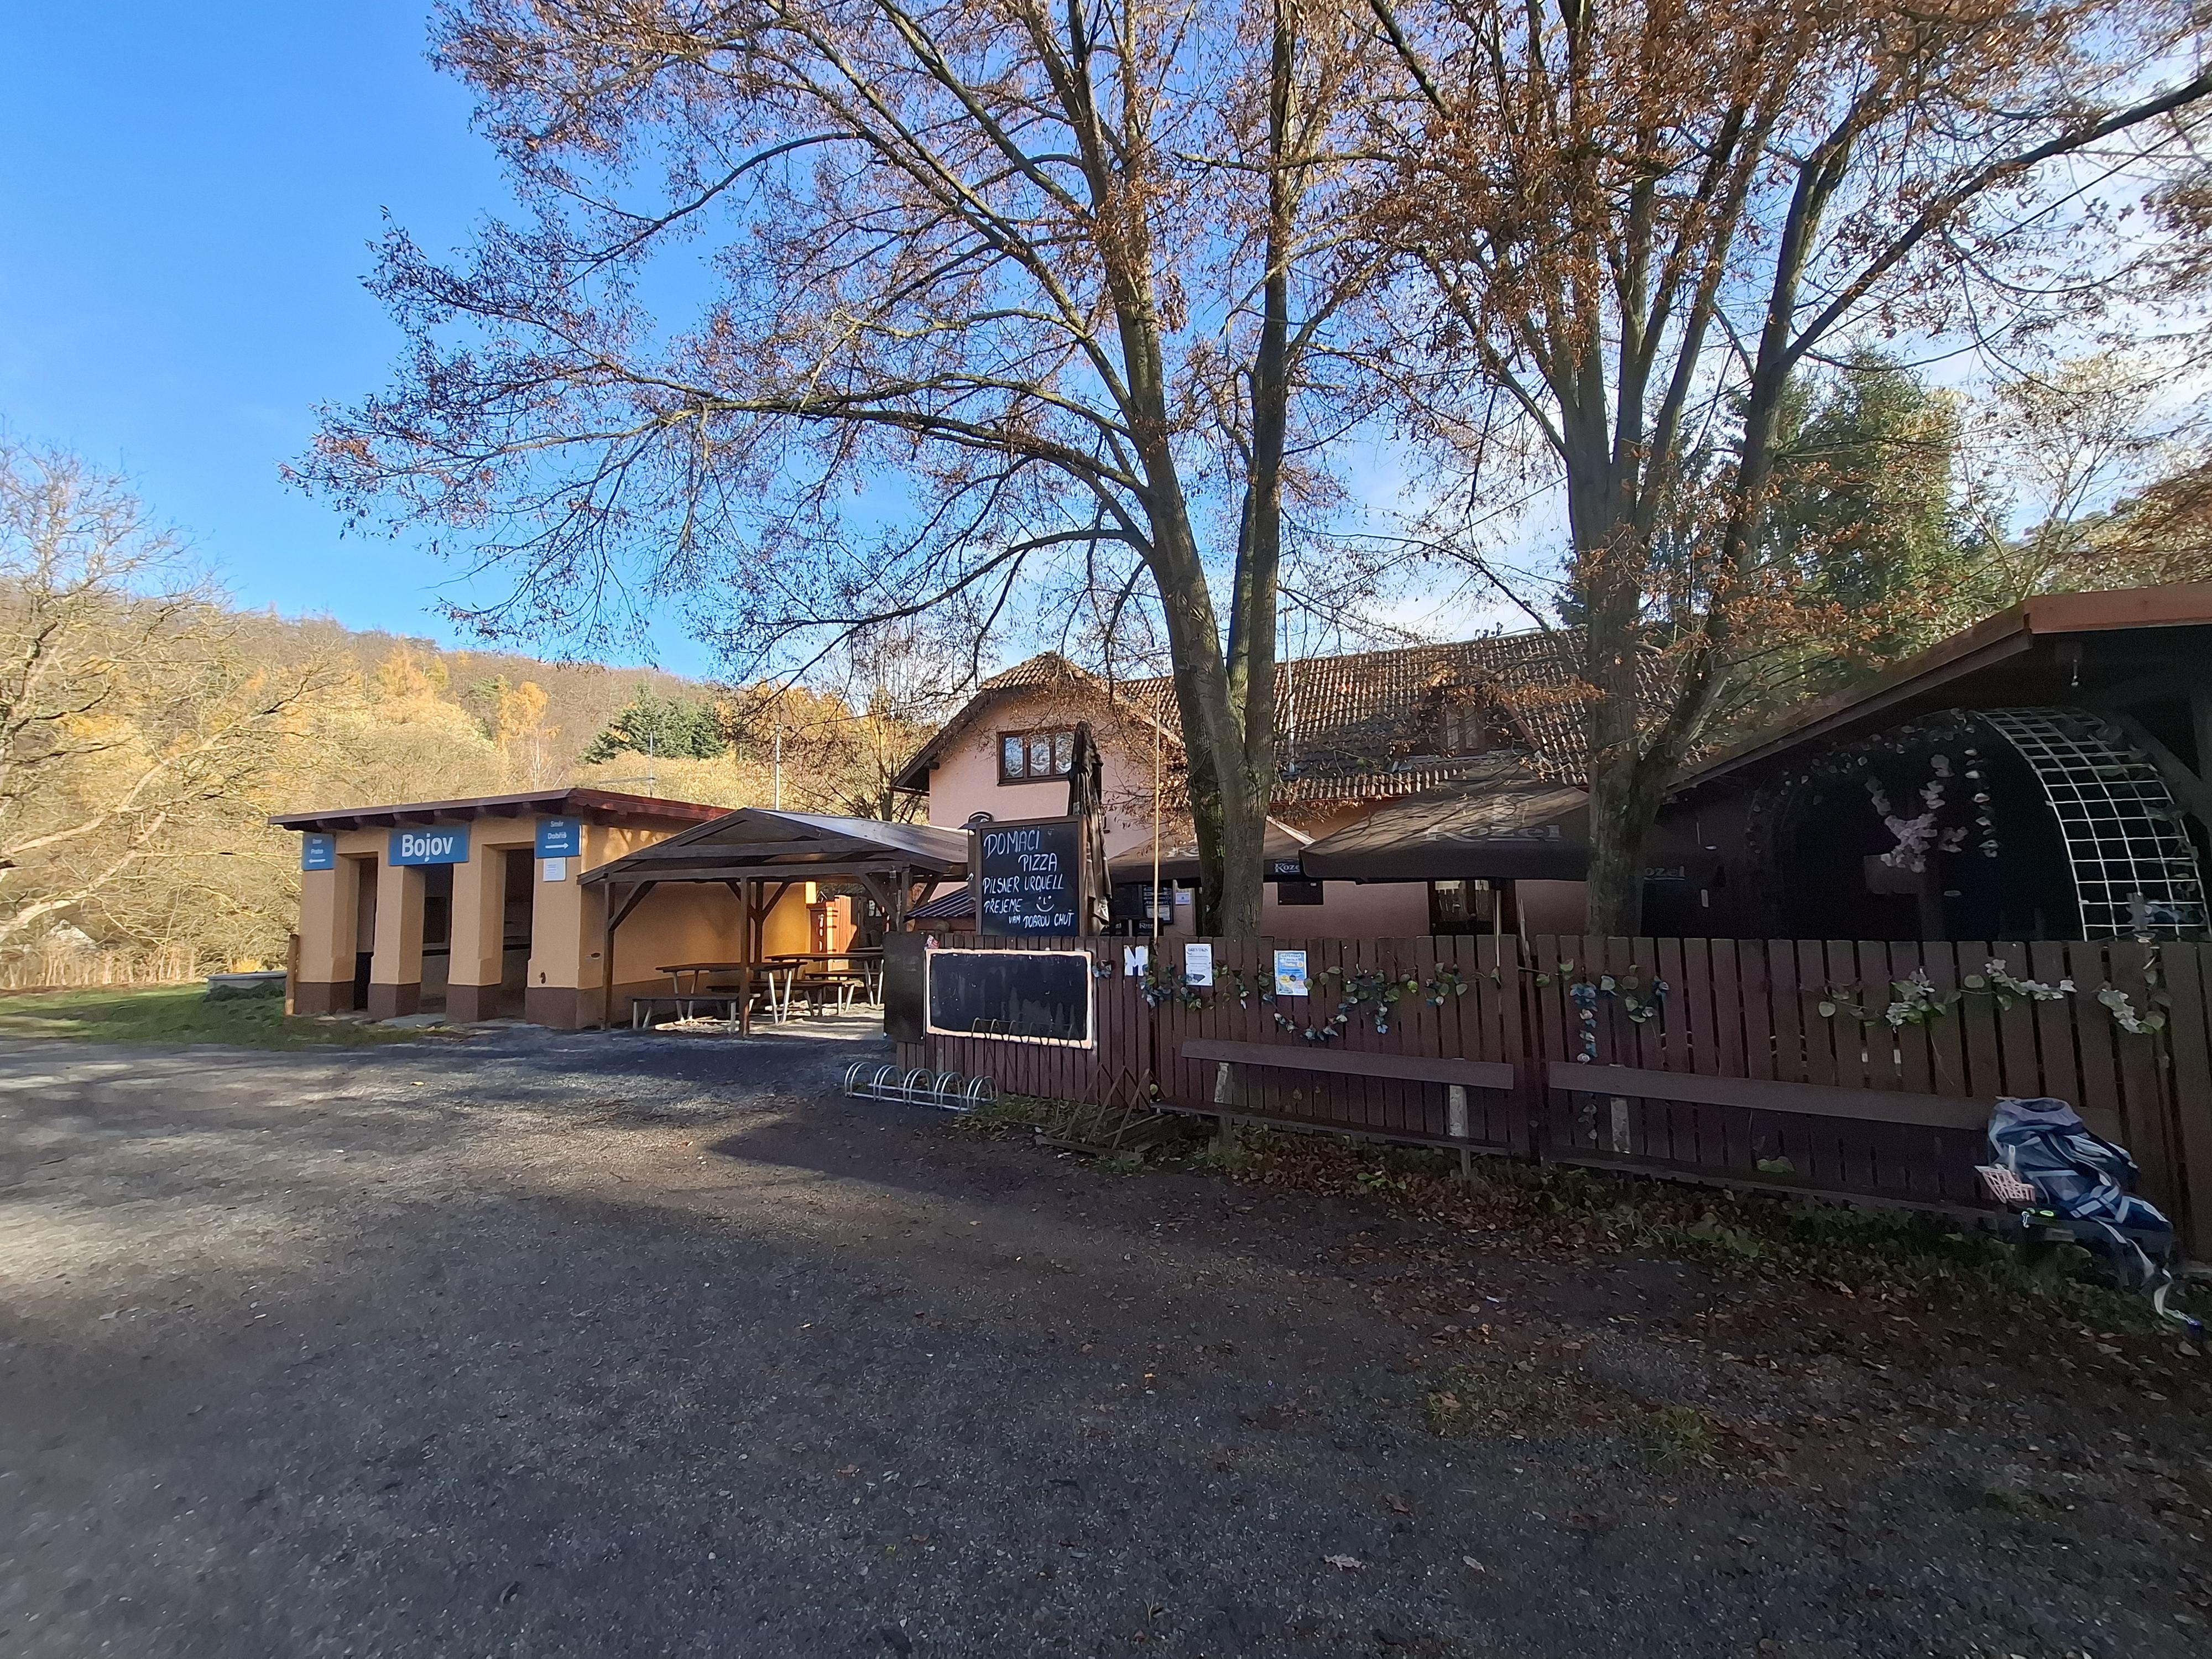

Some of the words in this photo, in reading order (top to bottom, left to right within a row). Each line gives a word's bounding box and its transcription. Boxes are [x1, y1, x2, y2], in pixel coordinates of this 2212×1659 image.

[401, 833, 453, 862] Bojov
[983, 825, 1040, 859] DOMÁCÍ
[1018, 853, 1057, 872] PIZZA
[1274, 863, 1301, 873] Koze
[1024, 873, 1065, 892] URQUELL
[1644, 866, 1686, 880] ozel
[1009, 912, 1021, 925] VÁM
[1023, 915, 1050, 929] DOBROU
